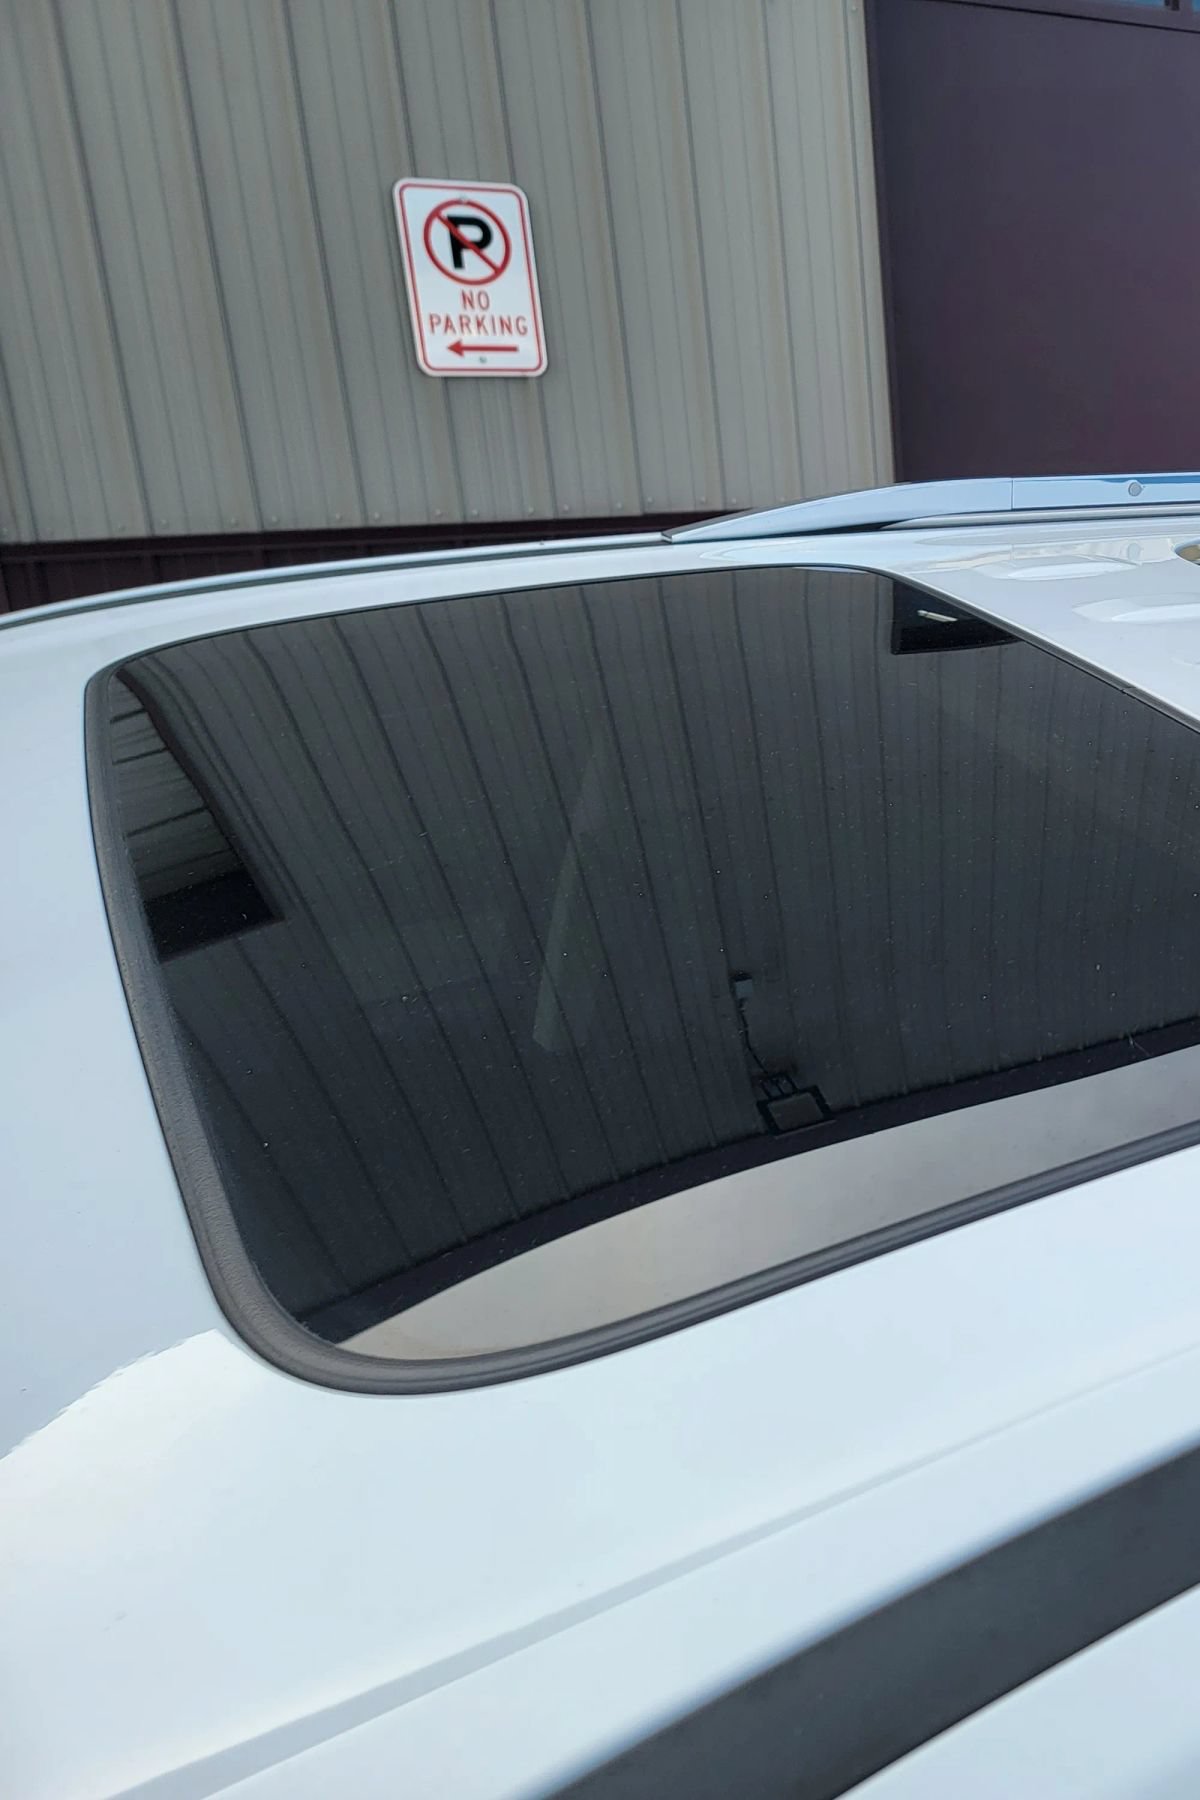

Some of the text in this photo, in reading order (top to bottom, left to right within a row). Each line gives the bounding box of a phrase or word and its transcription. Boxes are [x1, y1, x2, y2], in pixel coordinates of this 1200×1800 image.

[447, 215, 493, 269] P
[460, 289, 490, 311] NO
[428, 312, 528, 336] PARKING
